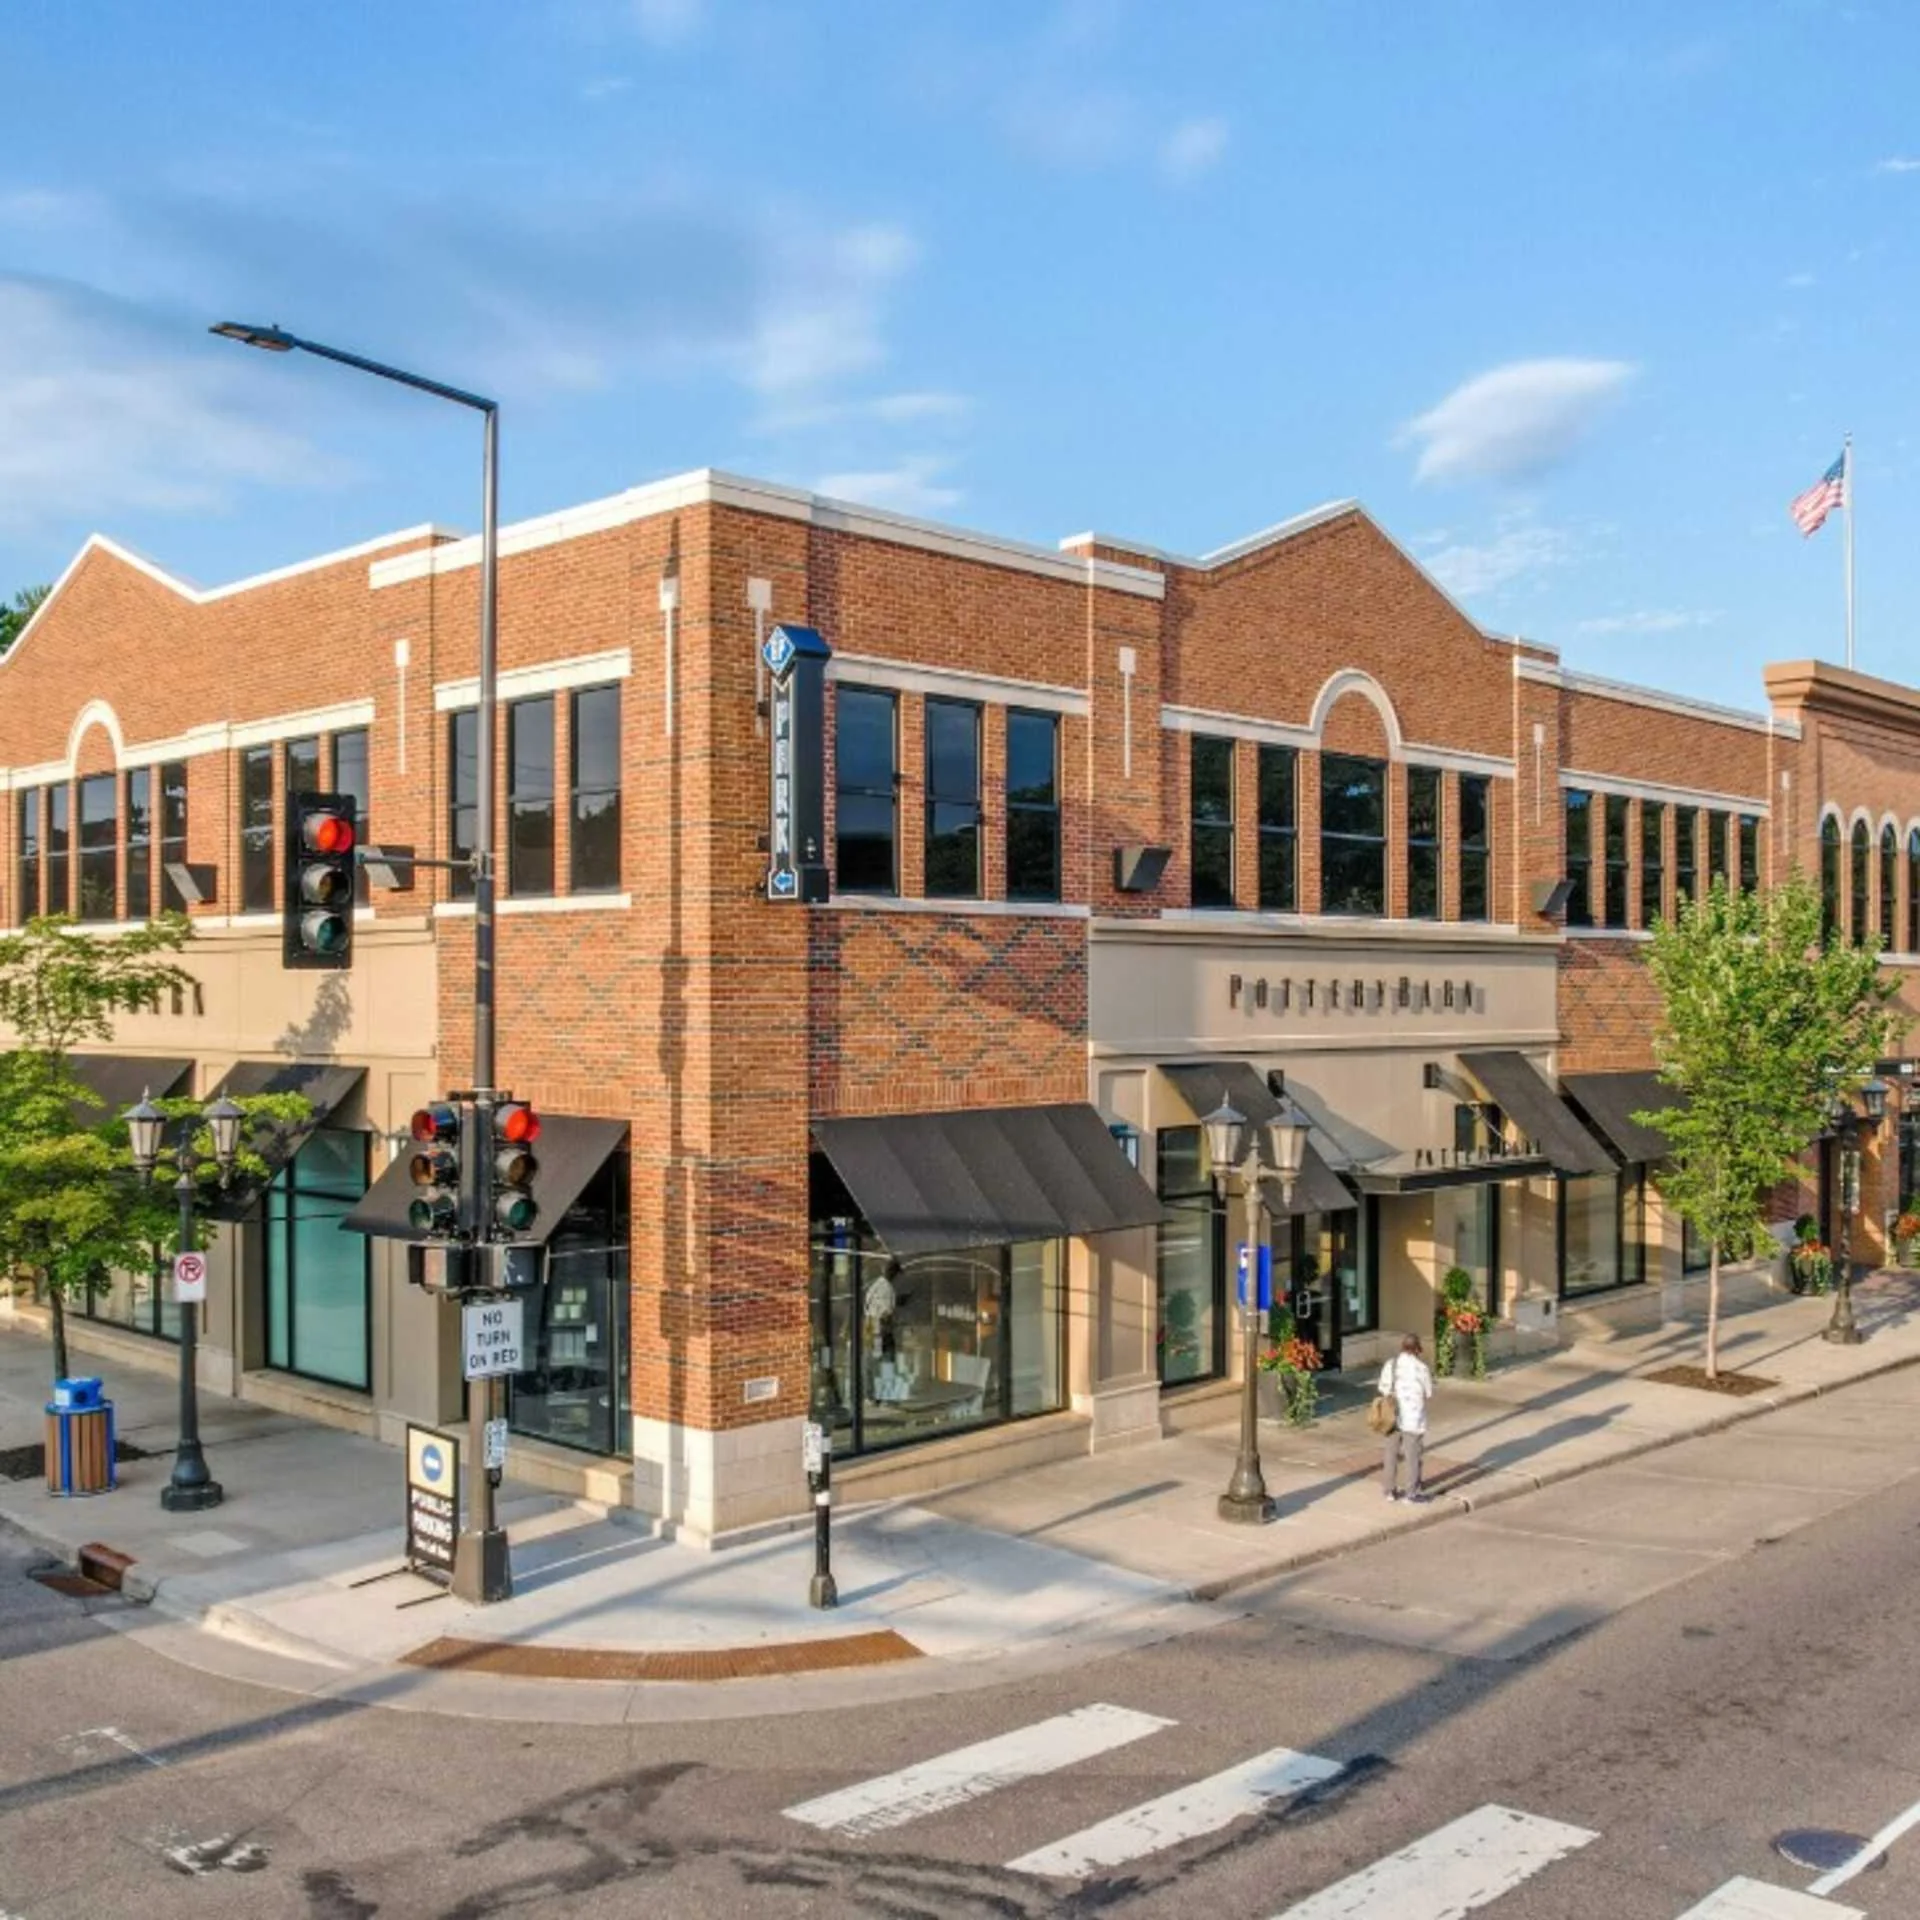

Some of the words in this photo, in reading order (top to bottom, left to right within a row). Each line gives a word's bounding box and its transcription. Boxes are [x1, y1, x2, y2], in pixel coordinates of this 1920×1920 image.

[482, 1310, 503, 1326] NO
[476, 1330, 511, 1347] TURN
[469, 1354, 487, 1369] ON
[493, 1348, 519, 1364] RED
